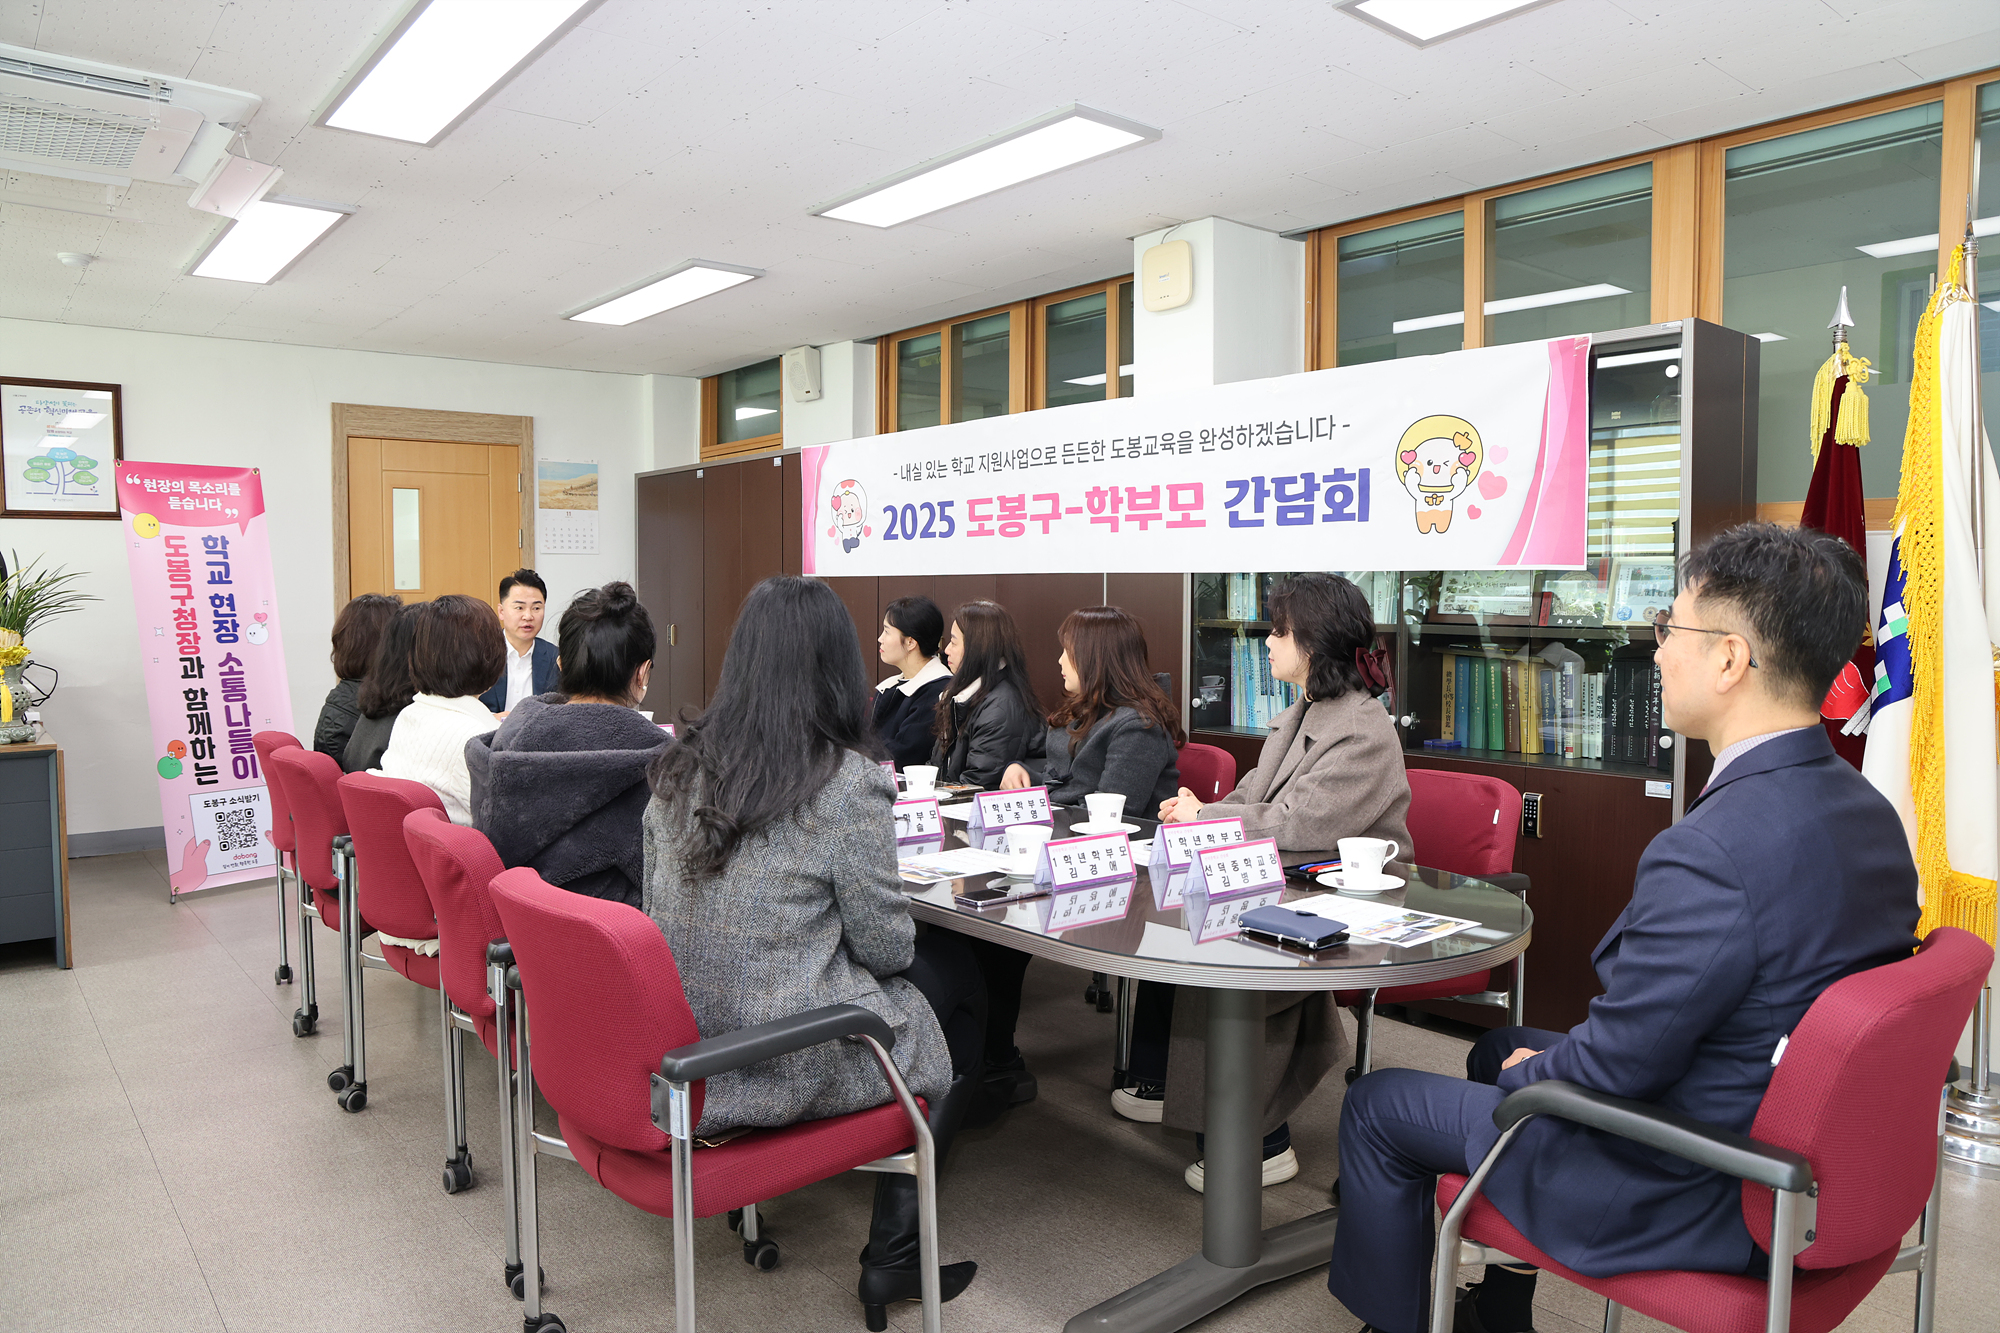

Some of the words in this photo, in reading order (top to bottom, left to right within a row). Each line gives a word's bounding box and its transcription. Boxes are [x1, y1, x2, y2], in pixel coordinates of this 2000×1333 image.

[900, 462, 922, 482] 내실
[926, 460, 948, 479] 있는
[951, 456, 975, 476] 학교
[978, 446, 1058, 473] 지원사업으로
[1062, 440, 1106, 465] 든든한
[1110, 430, 1194, 459] 도봉교육을
[1199, 414, 1336, 452] 완성하겠습니다
[188, 479, 241, 497] 목소리를
[882, 500, 956, 540] 2025
[966, 482, 1206, 538] 도봉구-학부모
[1224, 467, 1370, 528] 간담회
[202, 534, 233, 584] 학교
[164, 535, 205, 679] 도봉구청장과
[208, 593, 240, 644] 현장
[182, 688, 218, 786] 함께하는
[218, 652, 258, 780] 소통나들이
[204, 798, 227, 808] 도봉구
[229, 794, 260, 804] 소식받기
[233, 852, 258, 860] dobong
